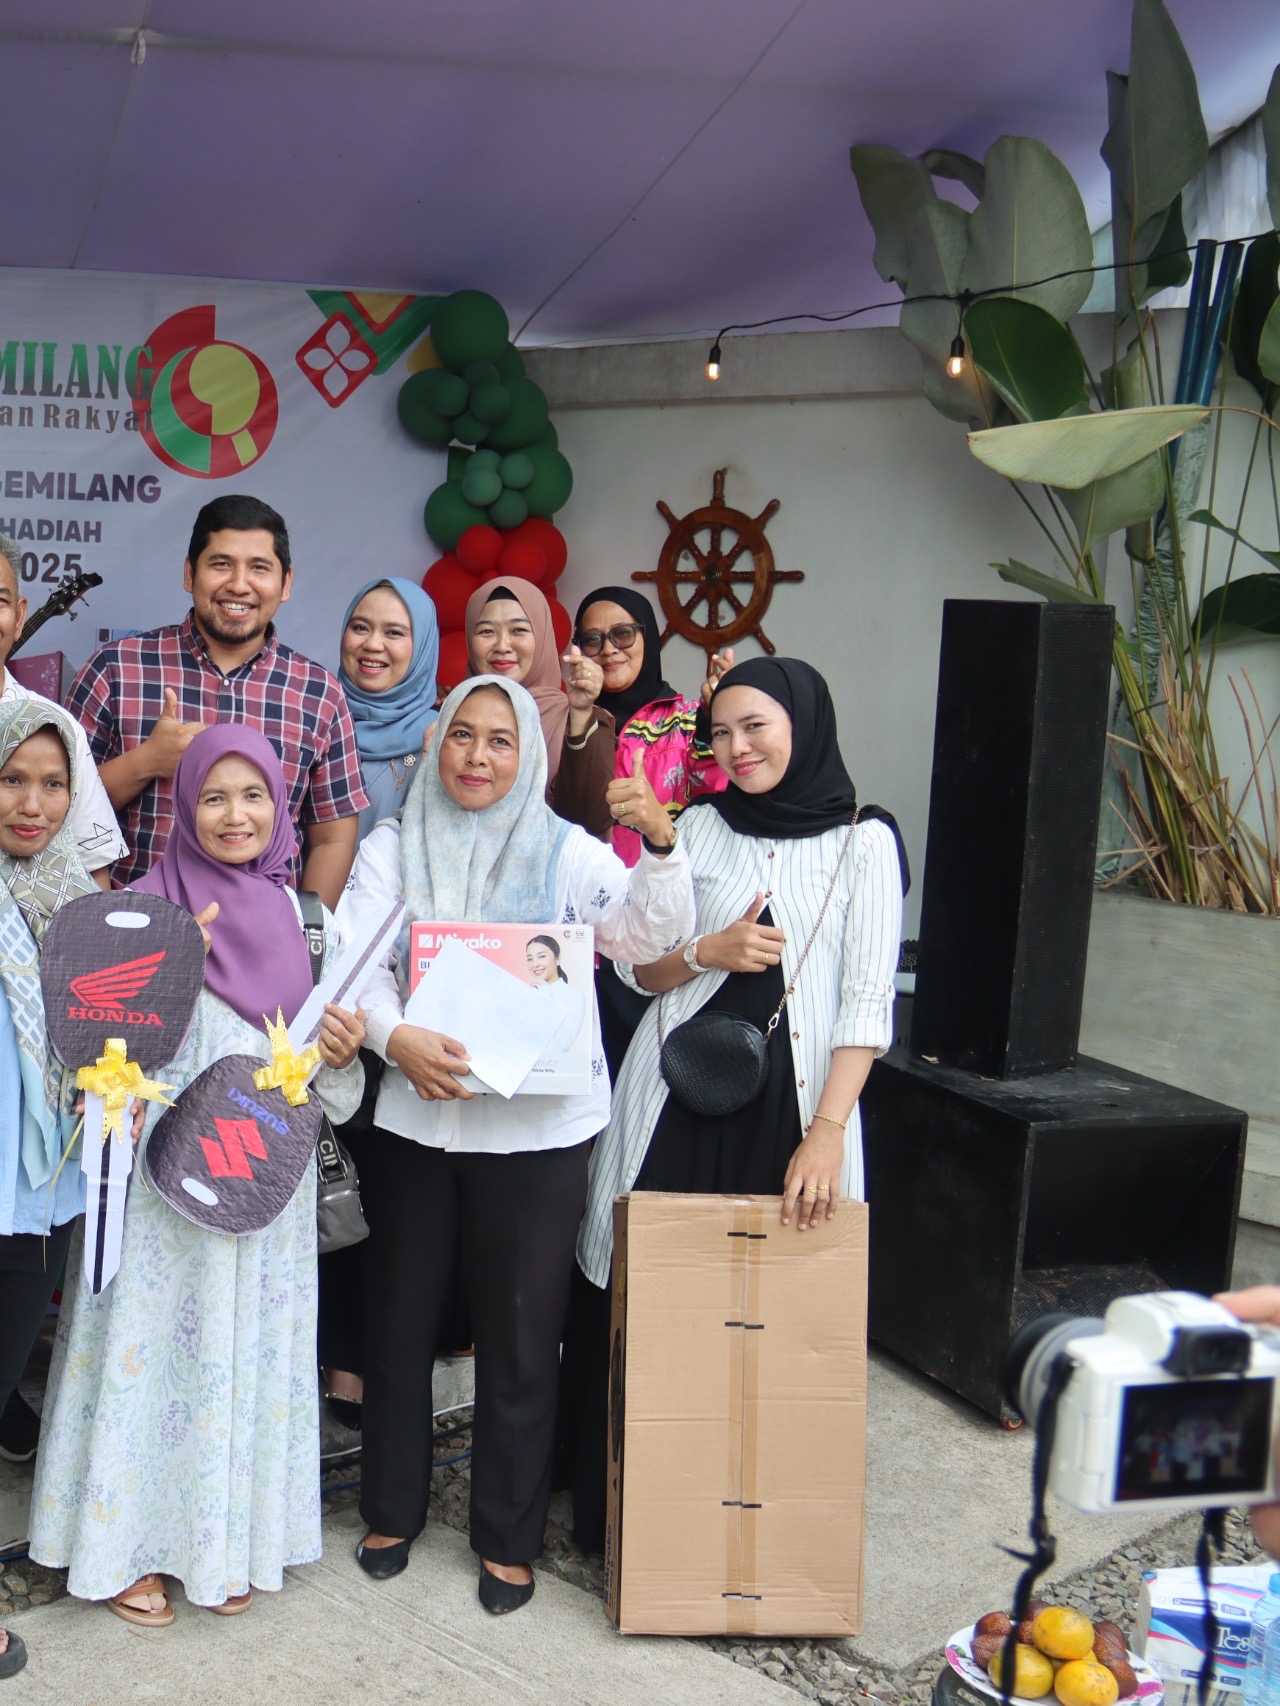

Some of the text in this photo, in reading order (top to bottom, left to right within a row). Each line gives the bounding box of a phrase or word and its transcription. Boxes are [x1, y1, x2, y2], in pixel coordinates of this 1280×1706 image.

[21, 551, 83, 584] 025
[67, 1006, 164, 1027] HONDA
[226, 1087, 290, 1136] SUZUKI
